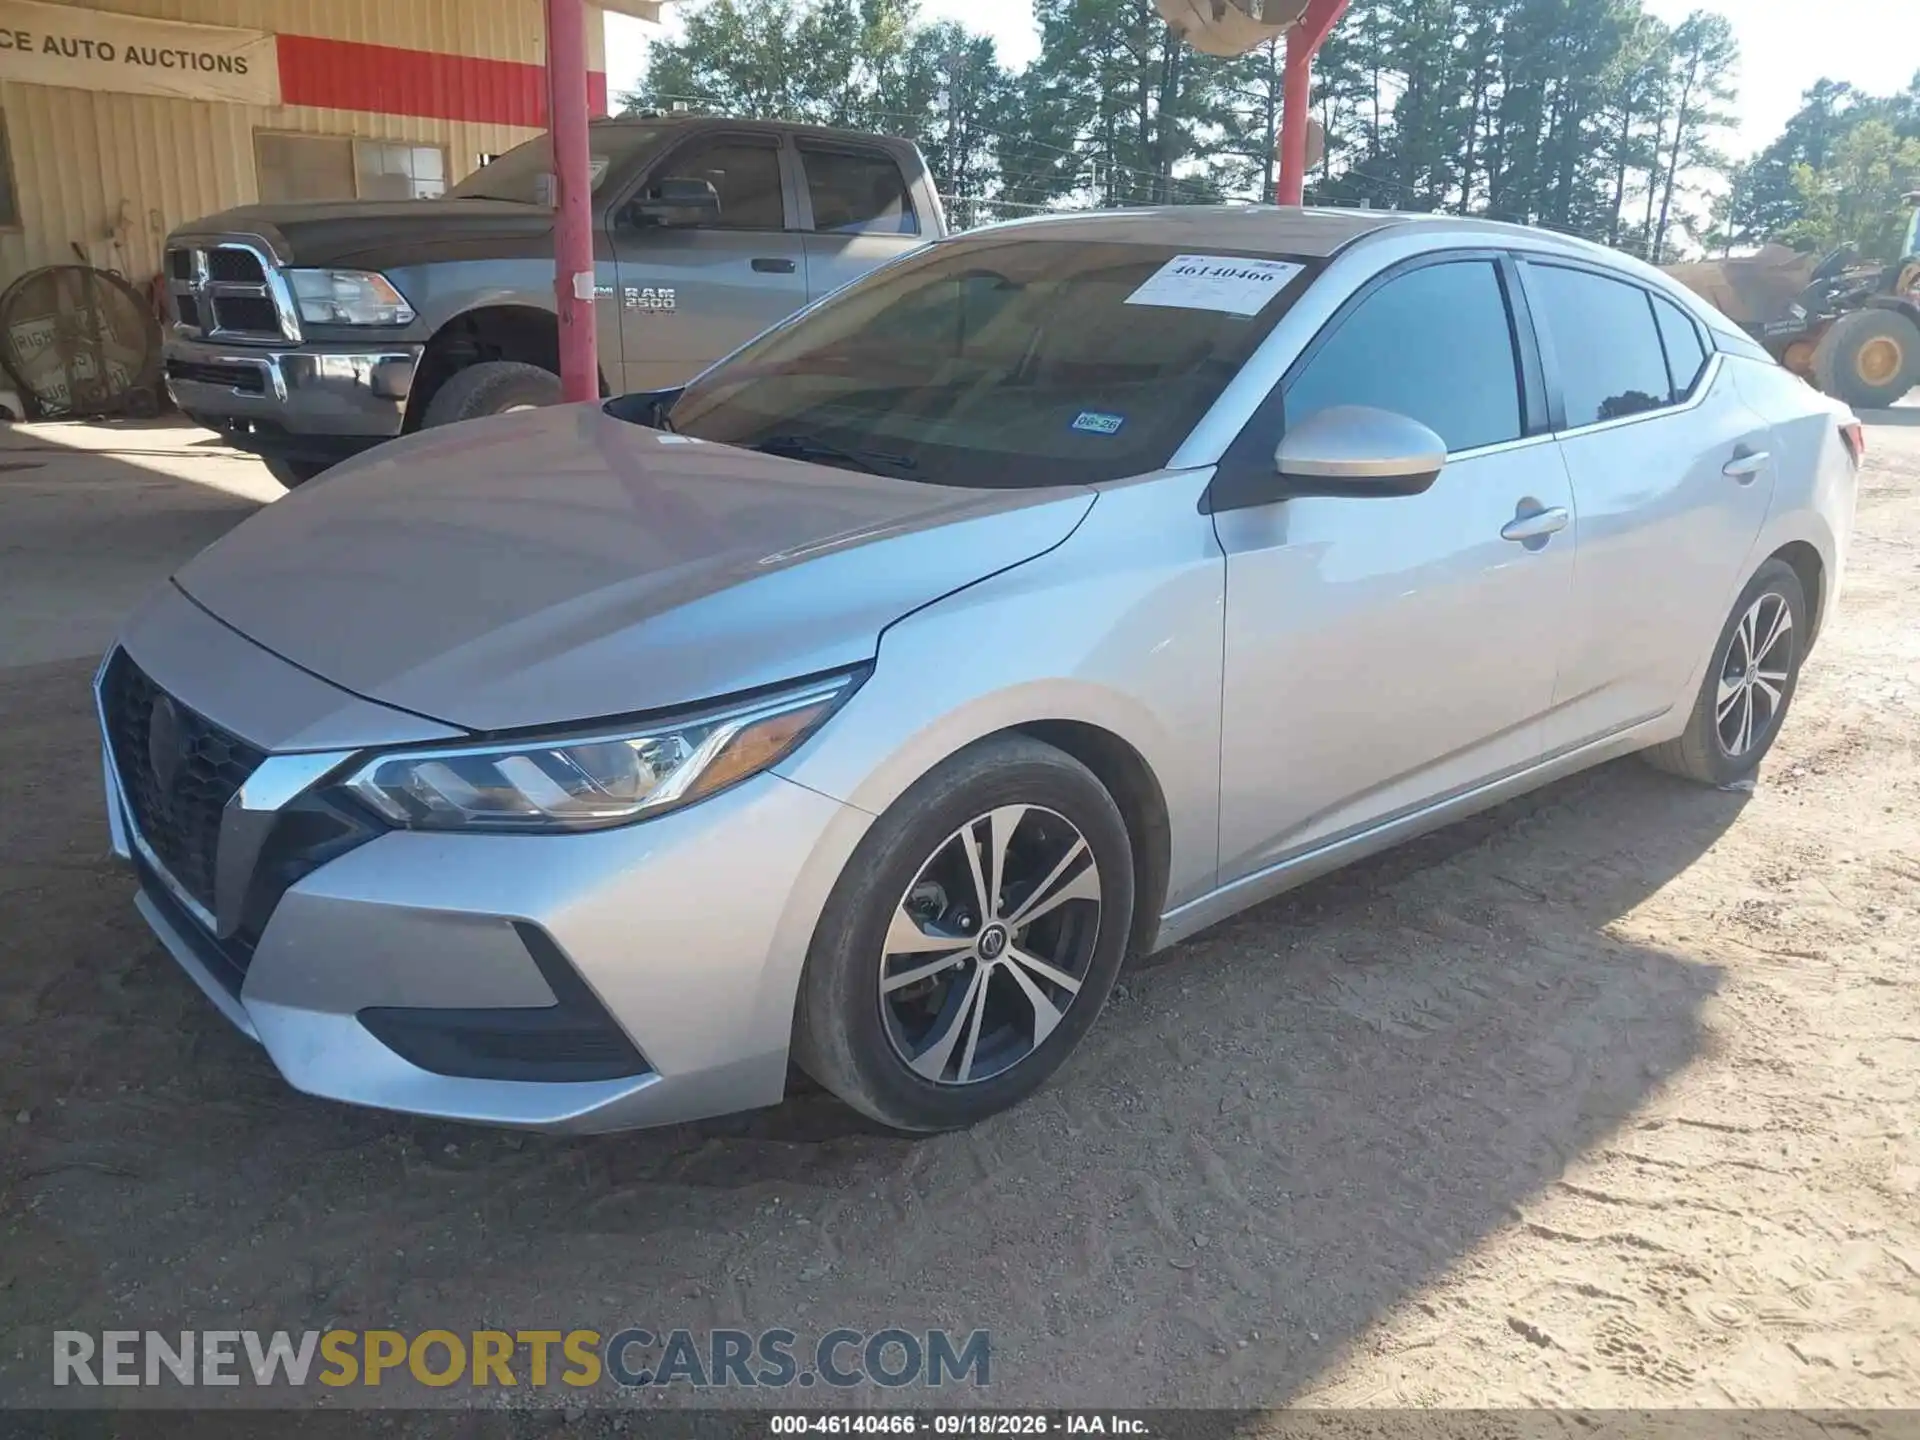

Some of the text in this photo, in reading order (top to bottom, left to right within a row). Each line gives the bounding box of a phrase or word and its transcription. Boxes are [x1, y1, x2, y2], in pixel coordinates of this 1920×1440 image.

[42, 36, 115, 62] AUTO
[124, 46, 248, 75] AUCTIONS
[1172, 264, 1275, 282] 46140466
[624, 287, 676, 298] RAM
